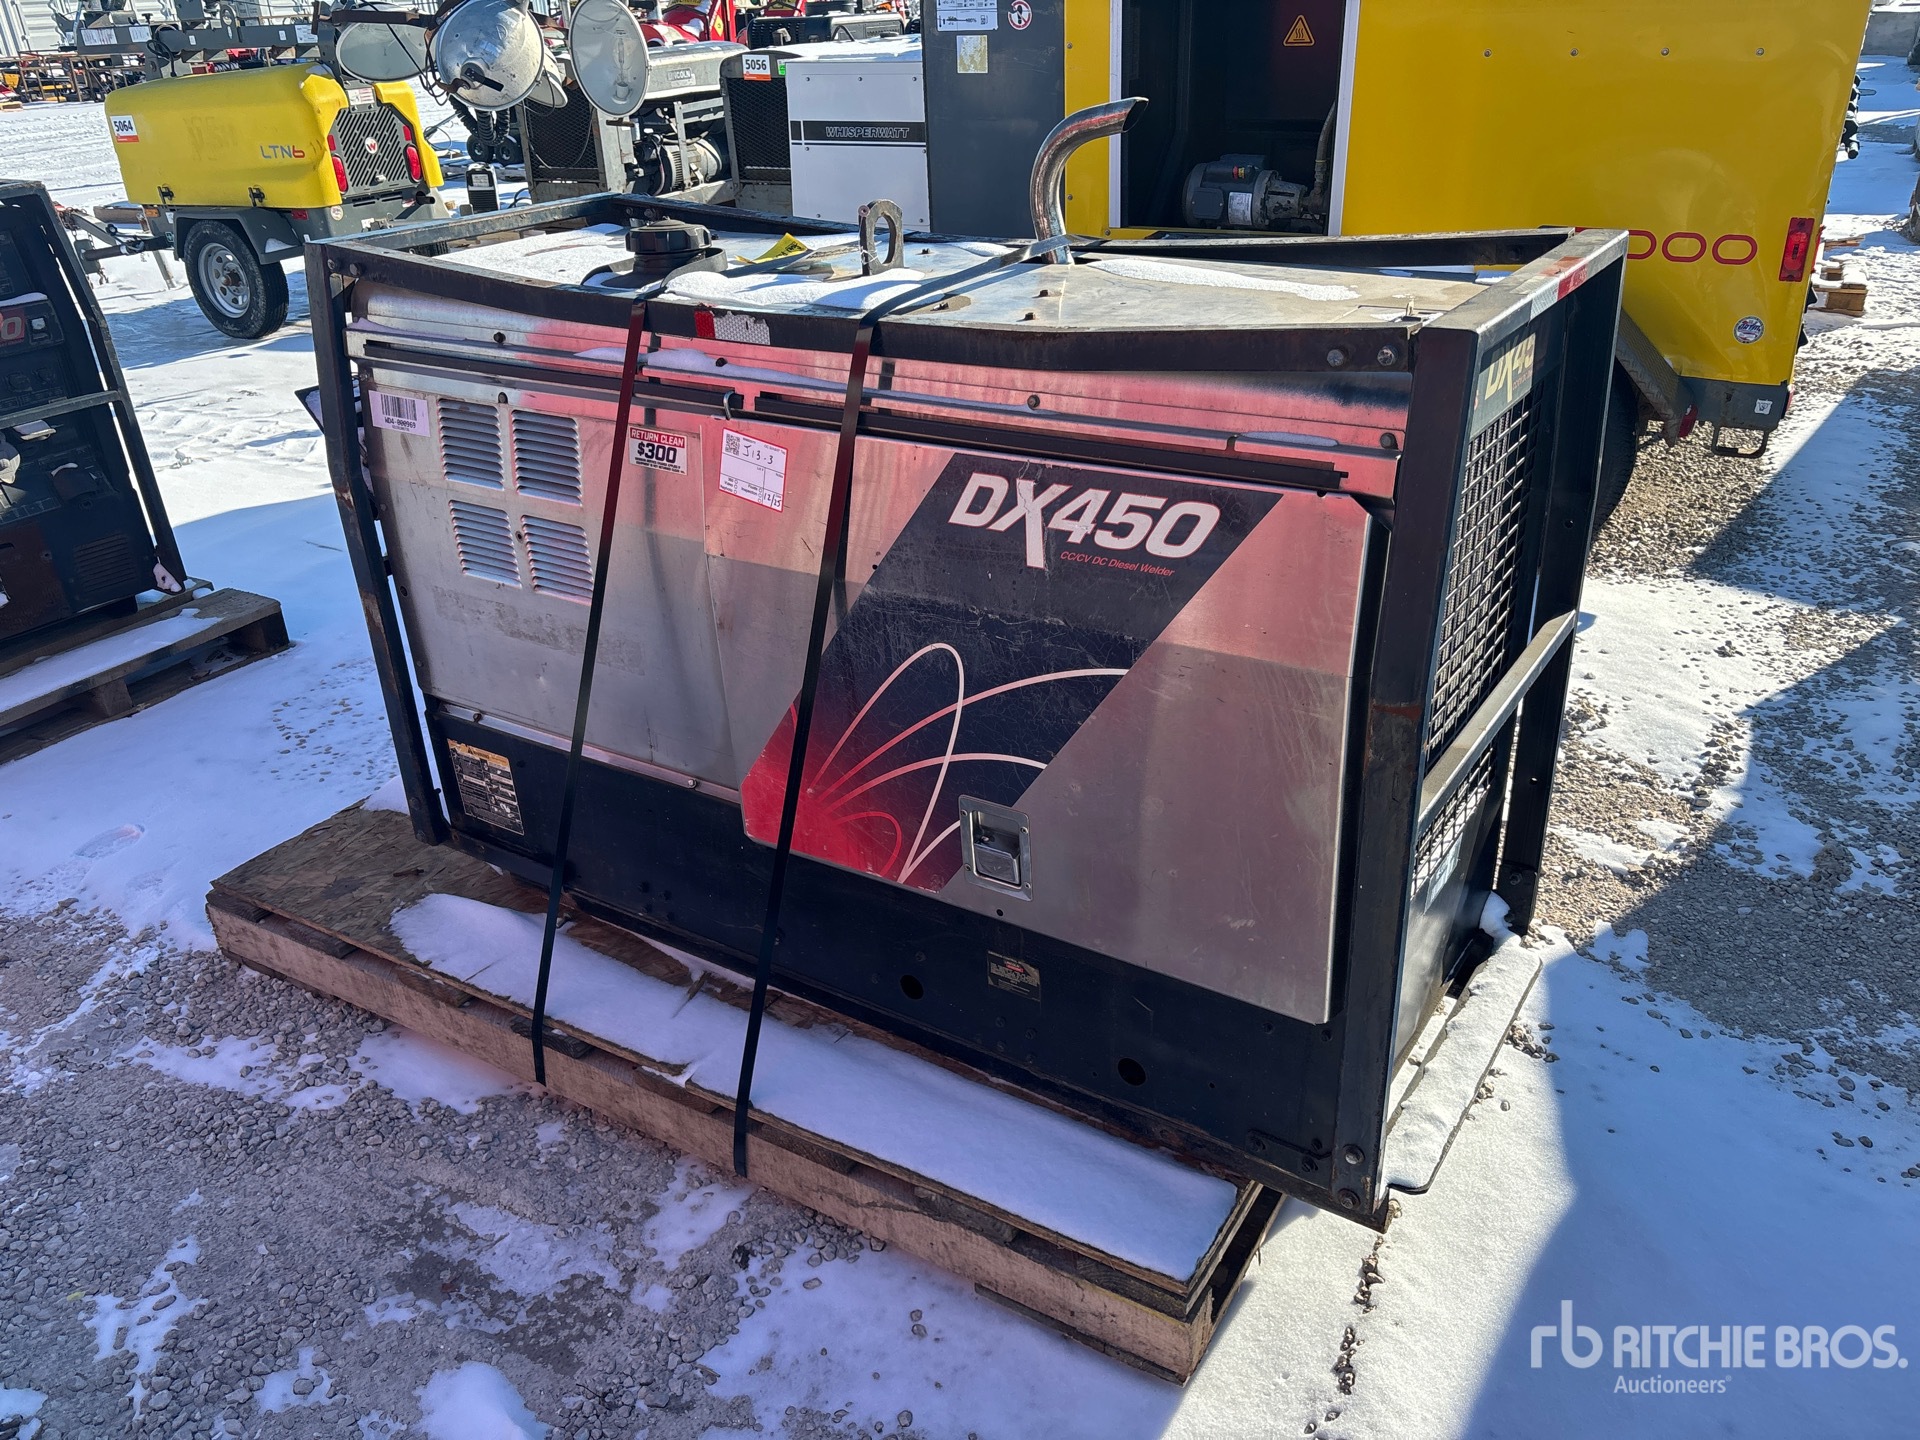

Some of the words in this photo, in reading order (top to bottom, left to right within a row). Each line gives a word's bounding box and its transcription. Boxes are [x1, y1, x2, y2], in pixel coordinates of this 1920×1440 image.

[745, 59, 767, 71] 5056
[113, 120, 133, 132] 5064
[825, 126, 910, 139] WHISPERWATT
[260, 144, 305, 159] LTN6
[1484, 328, 1543, 403] DX45
[631, 429, 659, 443] RETURN
[660, 434, 685, 447] CLEAN
[637, 441, 678, 464] $300
[947, 472, 1221, 569] DX450
[1060, 551, 1092, 564] CC/CV
[1092, 556, 1108, 566] DC
[1108, 559, 1139, 571] Diesel
[1140, 563, 1176, 577] Welder
